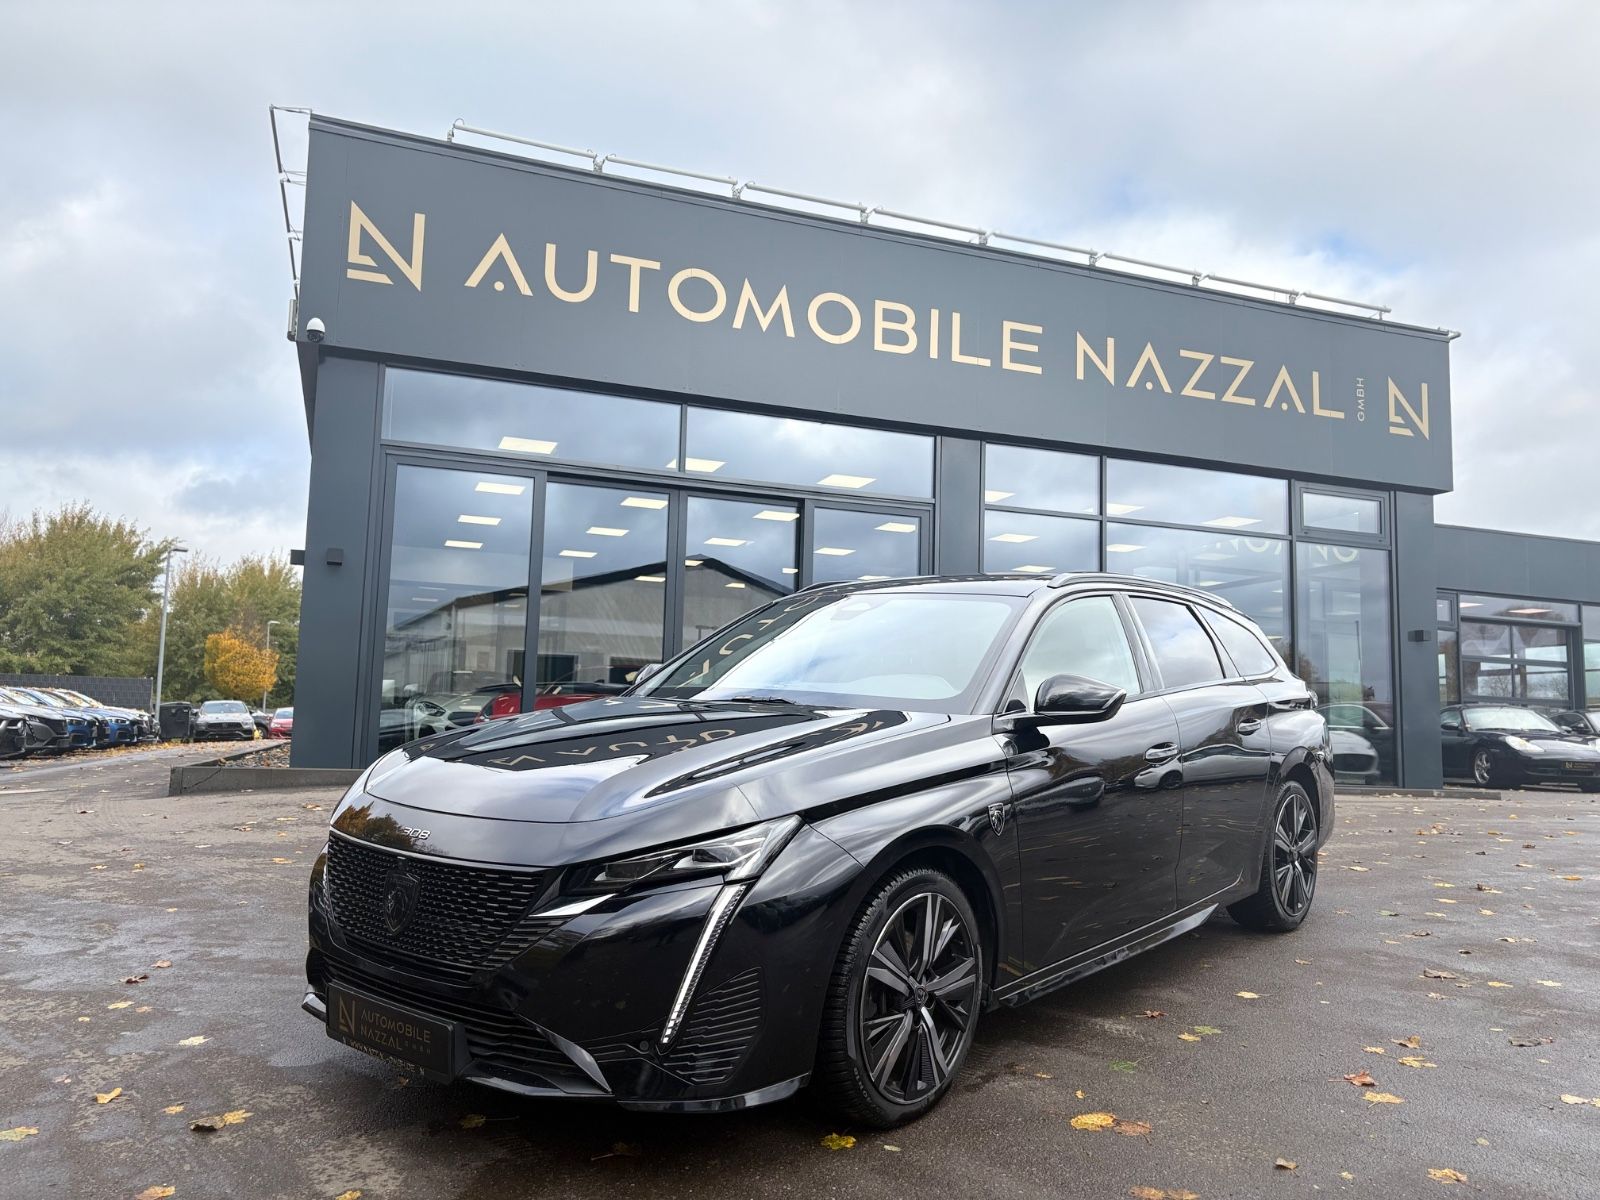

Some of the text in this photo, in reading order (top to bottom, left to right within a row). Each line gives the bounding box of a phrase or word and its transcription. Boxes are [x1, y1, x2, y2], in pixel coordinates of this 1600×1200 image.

[465, 233, 1043, 375] AUTOMOBILE
[1075, 333, 1345, 420] NAZZAL
[1355, 376, 1365, 422] GMBH
[402, 826, 431, 840] 308
[360, 1009, 431, 1043] AUTOMOBILE
[360, 1023, 402, 1051] NAZZAL
